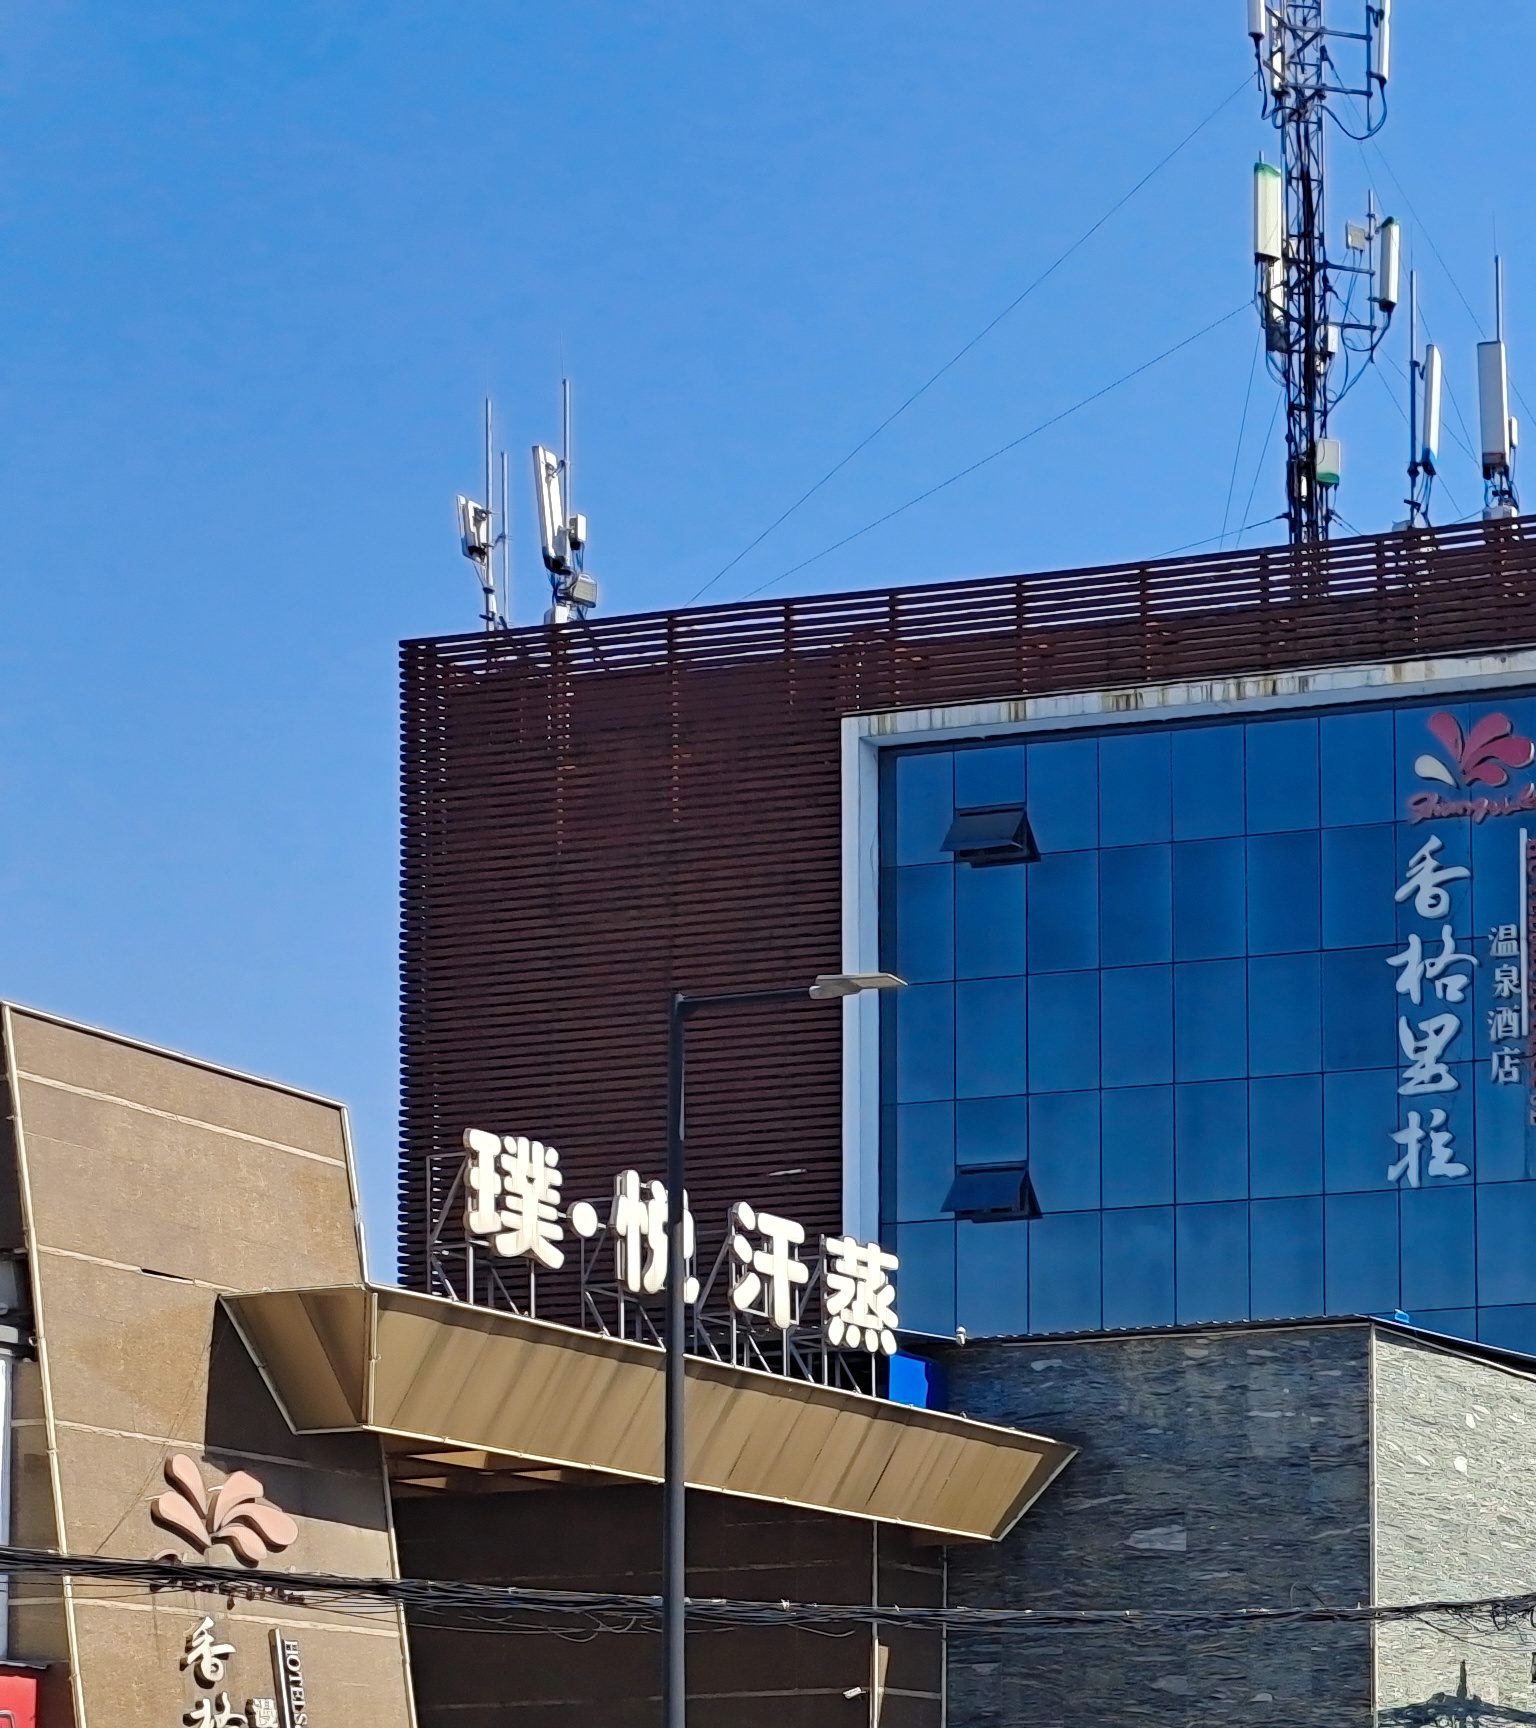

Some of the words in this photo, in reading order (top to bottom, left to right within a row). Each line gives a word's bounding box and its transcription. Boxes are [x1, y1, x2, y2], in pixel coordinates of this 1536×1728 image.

[1385, 833, 1479, 1189] 香格里拉
[1487, 923, 1523, 1085] 温泉酒店
